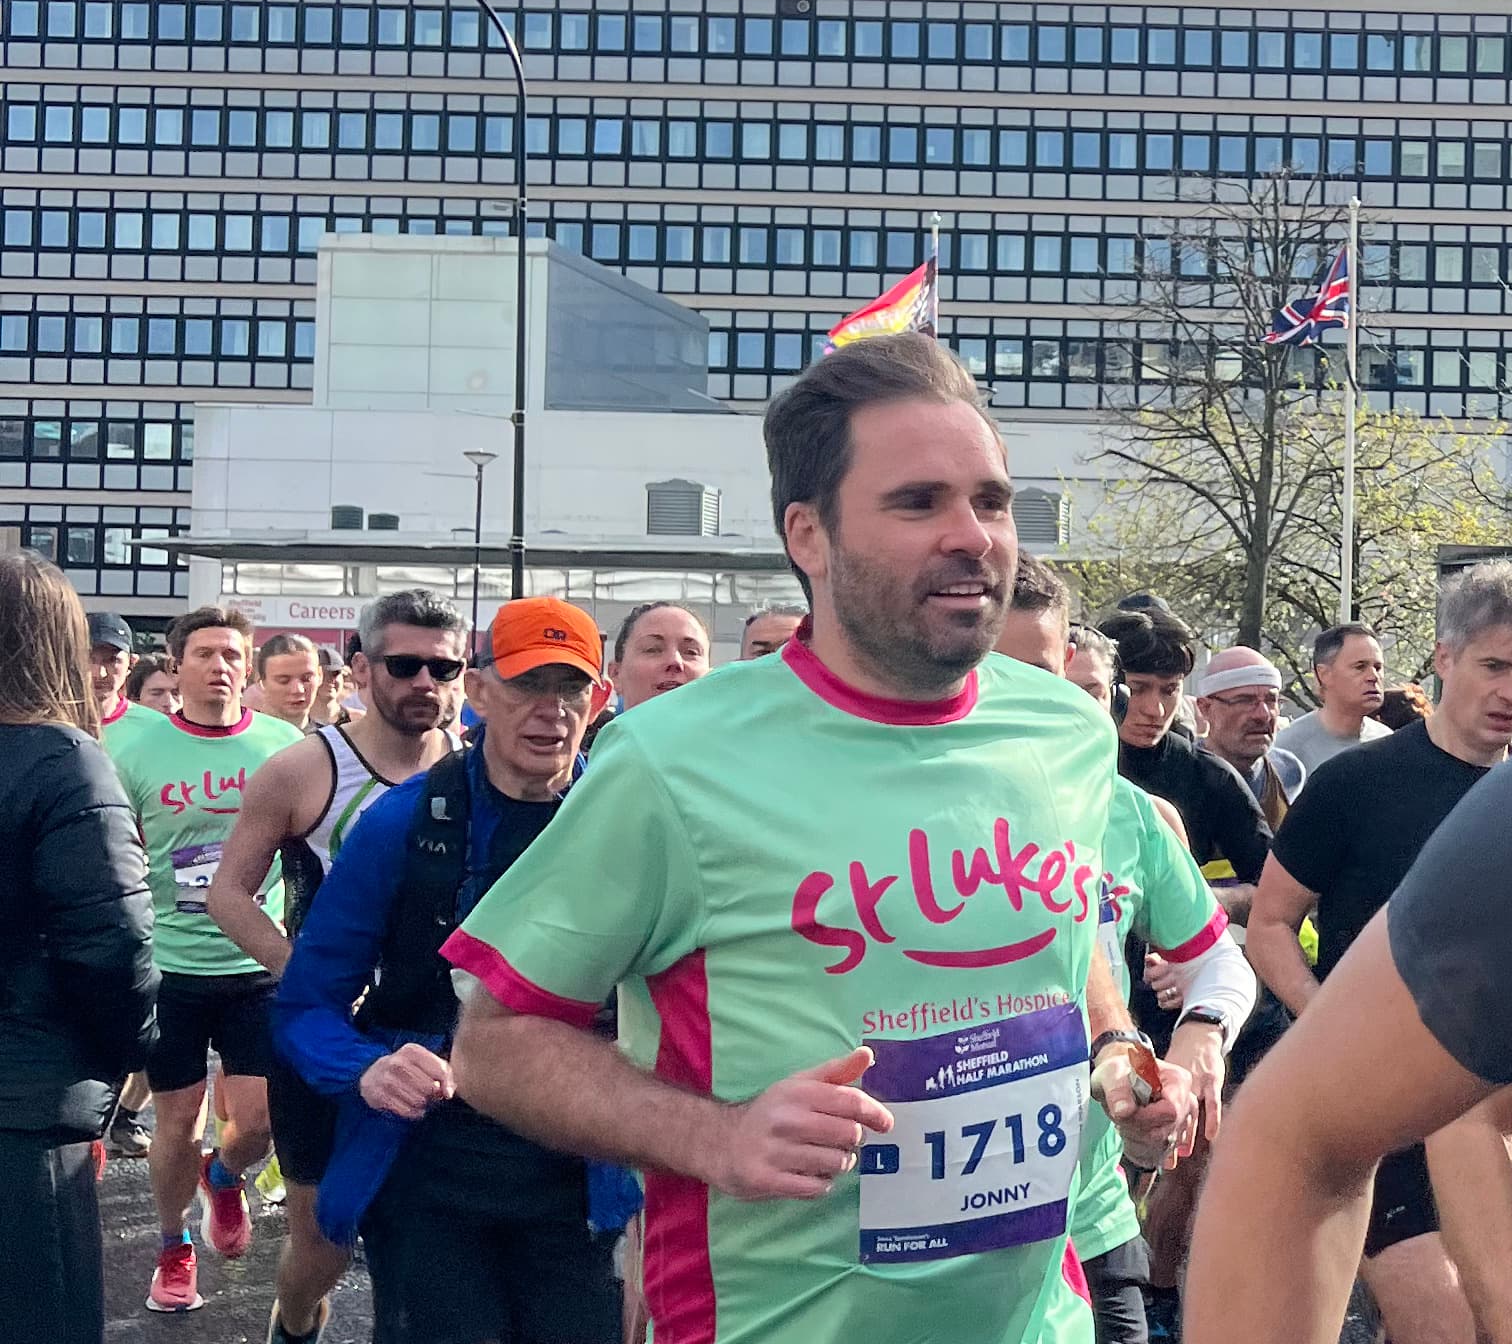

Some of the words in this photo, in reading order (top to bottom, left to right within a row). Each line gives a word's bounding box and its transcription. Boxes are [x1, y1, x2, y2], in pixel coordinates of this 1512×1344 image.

[289, 602, 355, 619] Careers
[160, 780, 197, 814] St
[791, 859, 898, 975] St
[908, 816, 1095, 923] Luke's
[862, 995, 990, 1035] Sheffield's
[996, 986, 1070, 1016] Hospice
[956, 1050, 1009, 1073] SHEFFIELD
[956, 1070, 984, 1086] HALF
[986, 1053, 1049, 1081] MARATHON
[924, 1103, 1067, 1180] 1718
[876, 1152, 885, 1169] L
[960, 1182, 1031, 1211] JONNY
[876, 1242, 902, 1253] RUN
[903, 1240, 927, 1251] FOR
[928, 1237, 949, 1248] ALL
